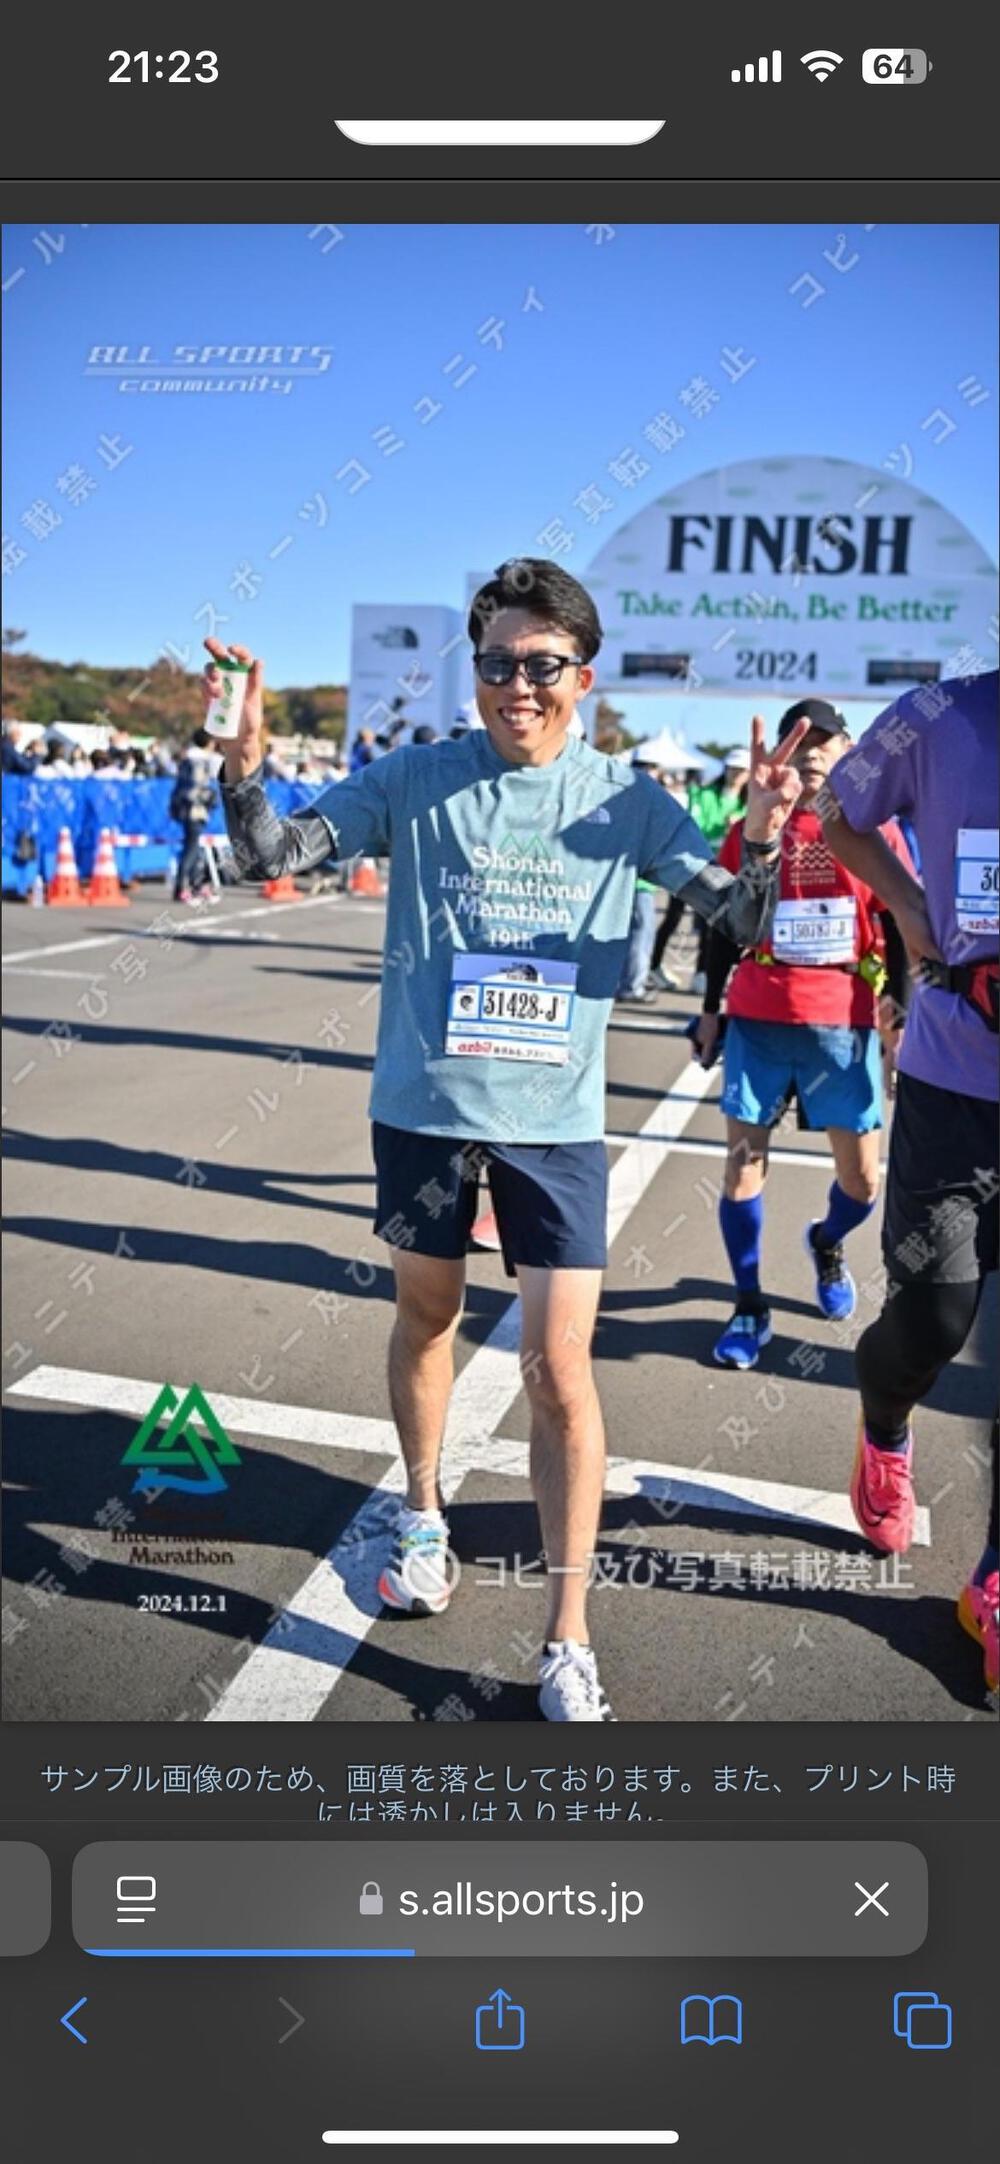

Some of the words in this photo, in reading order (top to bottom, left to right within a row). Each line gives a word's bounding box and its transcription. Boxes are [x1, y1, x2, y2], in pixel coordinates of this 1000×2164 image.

[108, 51, 219, 83] 21:23
[873, 54, 914, 80] 64
[665, 514, 914, 577] FINISH
[617, 591, 684, 617] Take
[807, 594, 848, 622] Be
[856, 594, 960, 623] Better
[735, 649, 818, 681] 2024
[472, 846, 565, 876] Shonan
[438, 867, 593, 903] International
[455, 893, 573, 925] Marathon
[488, 928, 536, 951] 19th
[483, 989, 560, 1023] 31428-J
[40, 1764, 957, 1796] サンプル画像のため、画質を落としております。また、プリント時
[398, 1881, 646, 1923] s.allsports.jp
